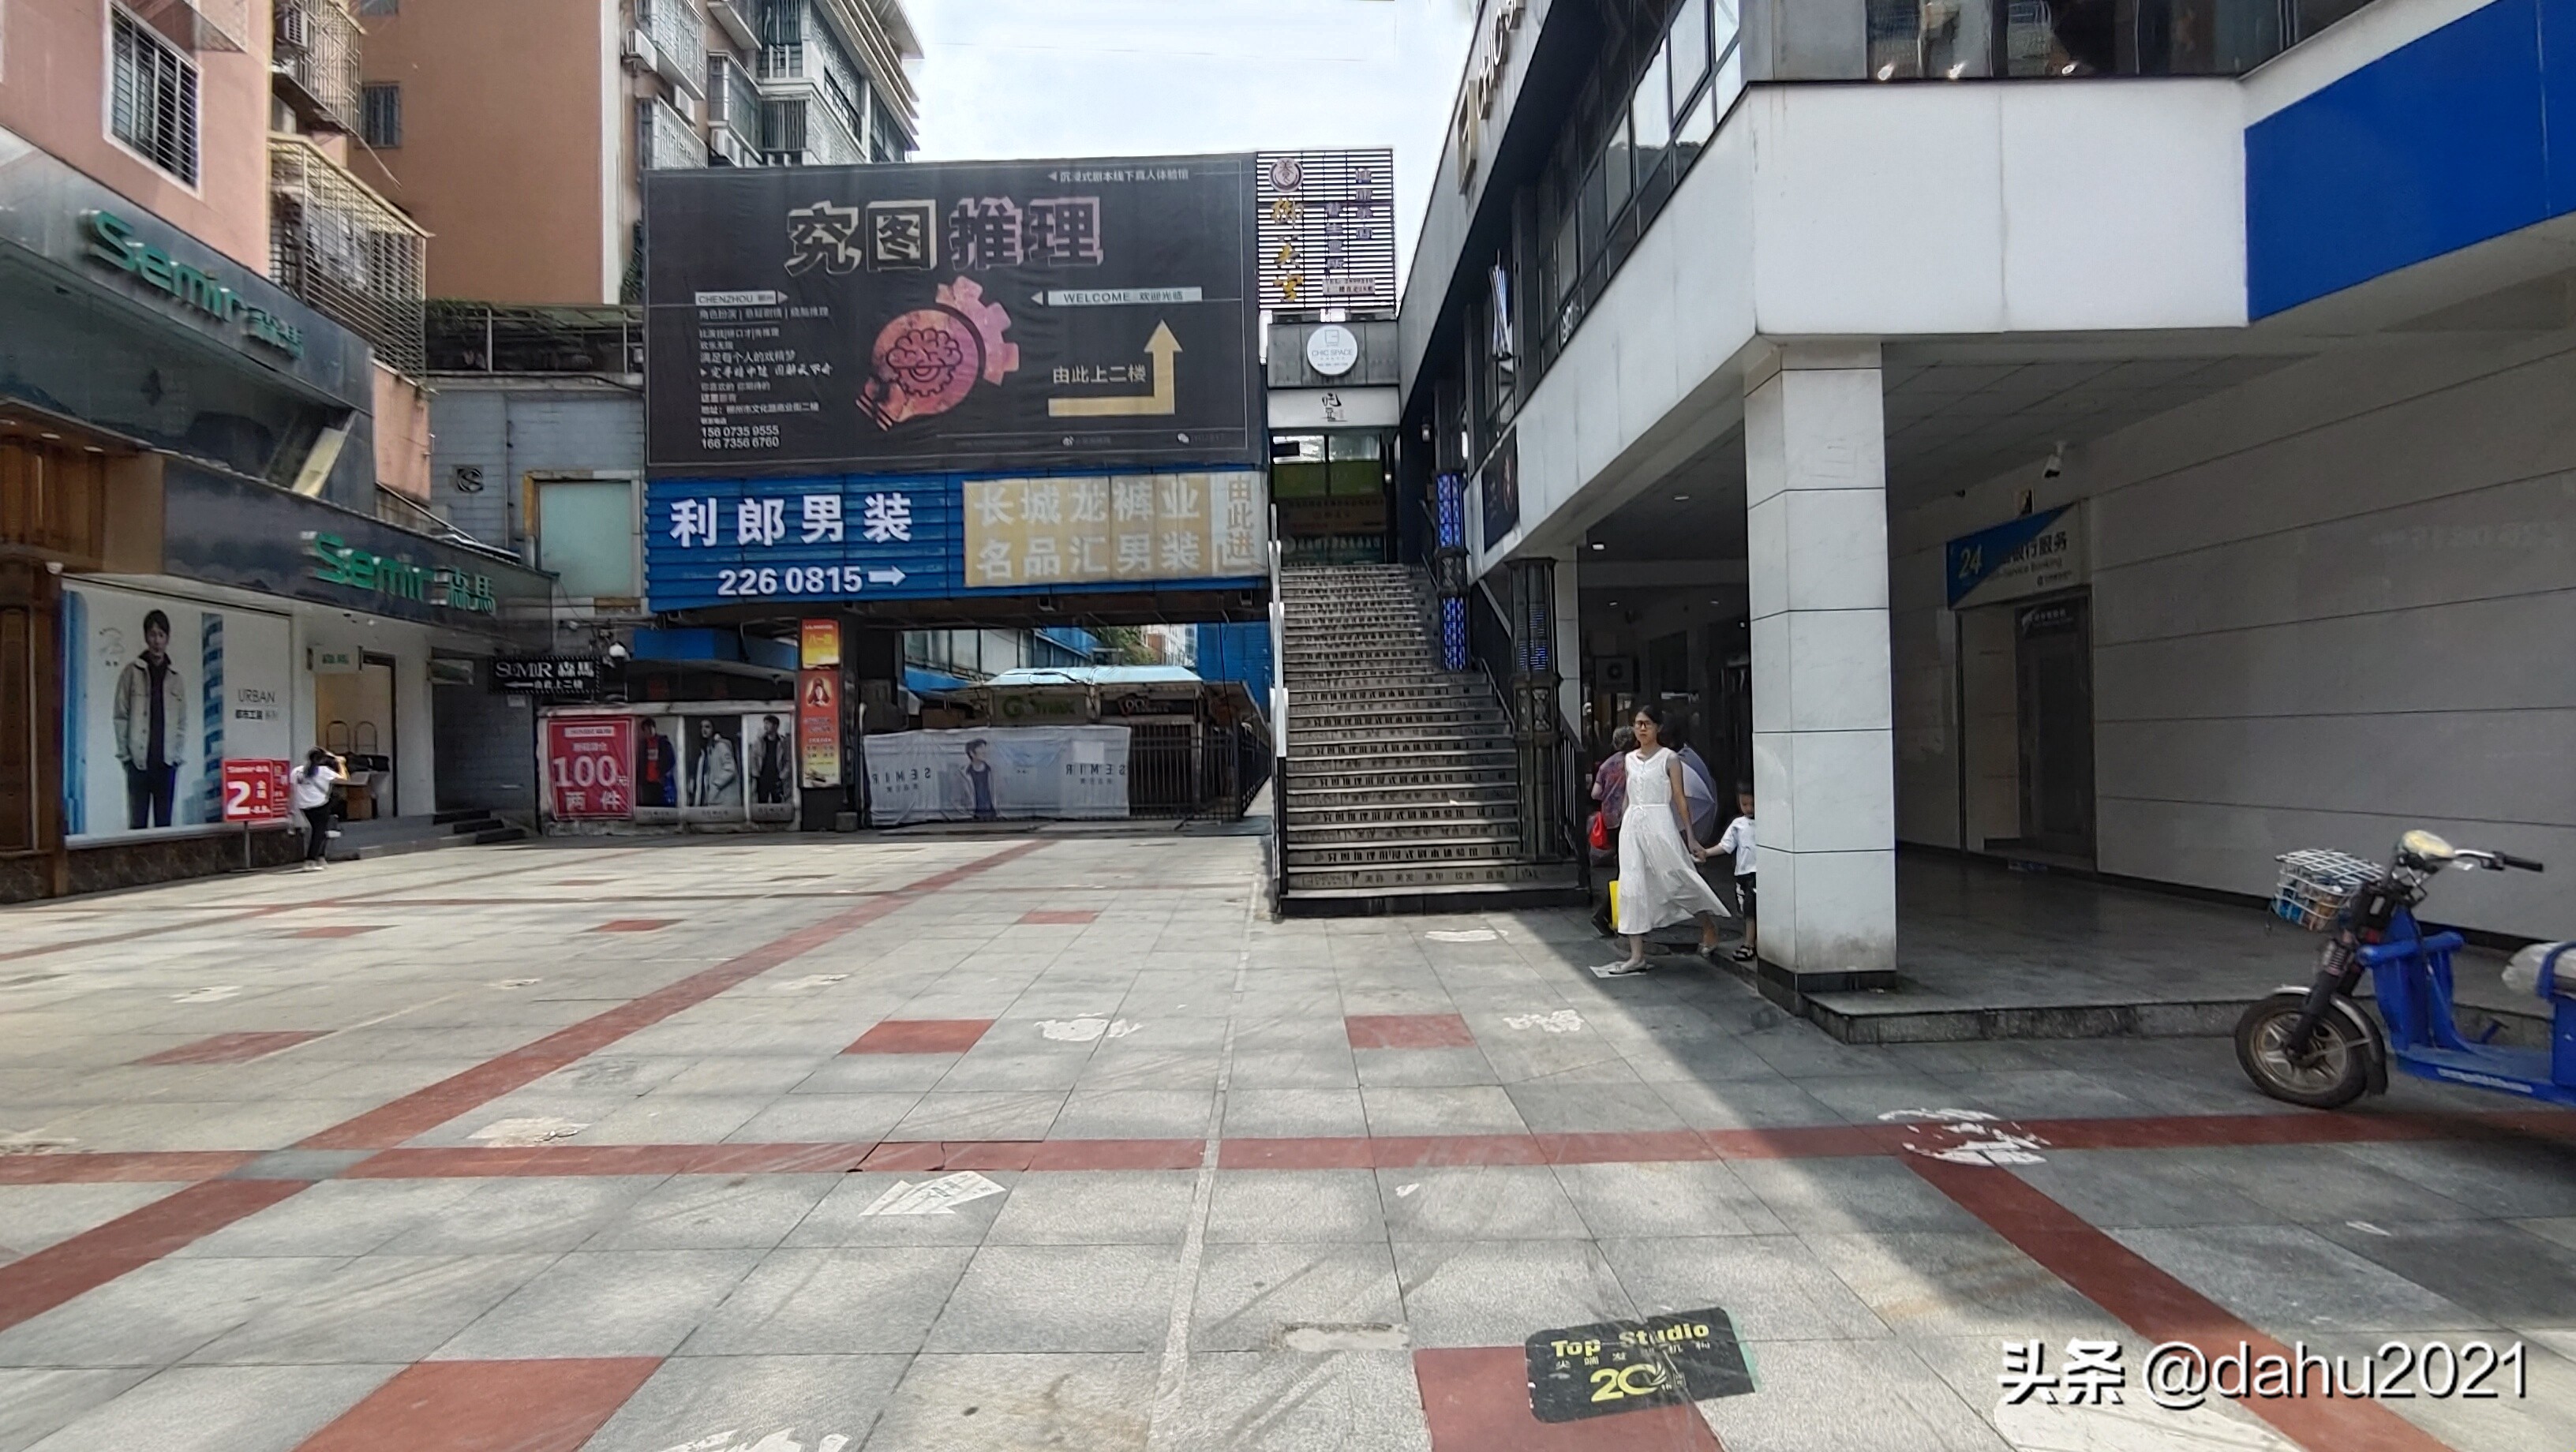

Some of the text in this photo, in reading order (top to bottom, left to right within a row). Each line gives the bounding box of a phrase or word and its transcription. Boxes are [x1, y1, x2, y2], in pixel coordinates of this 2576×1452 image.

[783, 195, 1105, 278] 究图推理
[80, 208, 245, 324] Semir
[698, 294, 754, 304] CHENZHOU
[1063, 290, 1184, 304] WELCOME 欢迎光临
[1053, 364, 1147, 385] 由此上二楼
[701, 425, 780, 438] 156 0735 9555
[701, 436, 780, 450] 166 7356 6760
[669, 492, 912, 548] 利郎男装
[974, 479, 1200, 528] 长城龙裤业
[309, 531, 435, 601] Semir
[976, 532, 1200, 580] 名品汇男装
[1958, 544, 1983, 579] 24
[717, 565, 863, 597] 226 0815
[238, 688, 275, 703] URBAN
[553, 754, 617, 788] 100
[227, 780, 251, 815] 2
[1551, 1323, 1709, 1357] Top Studio
